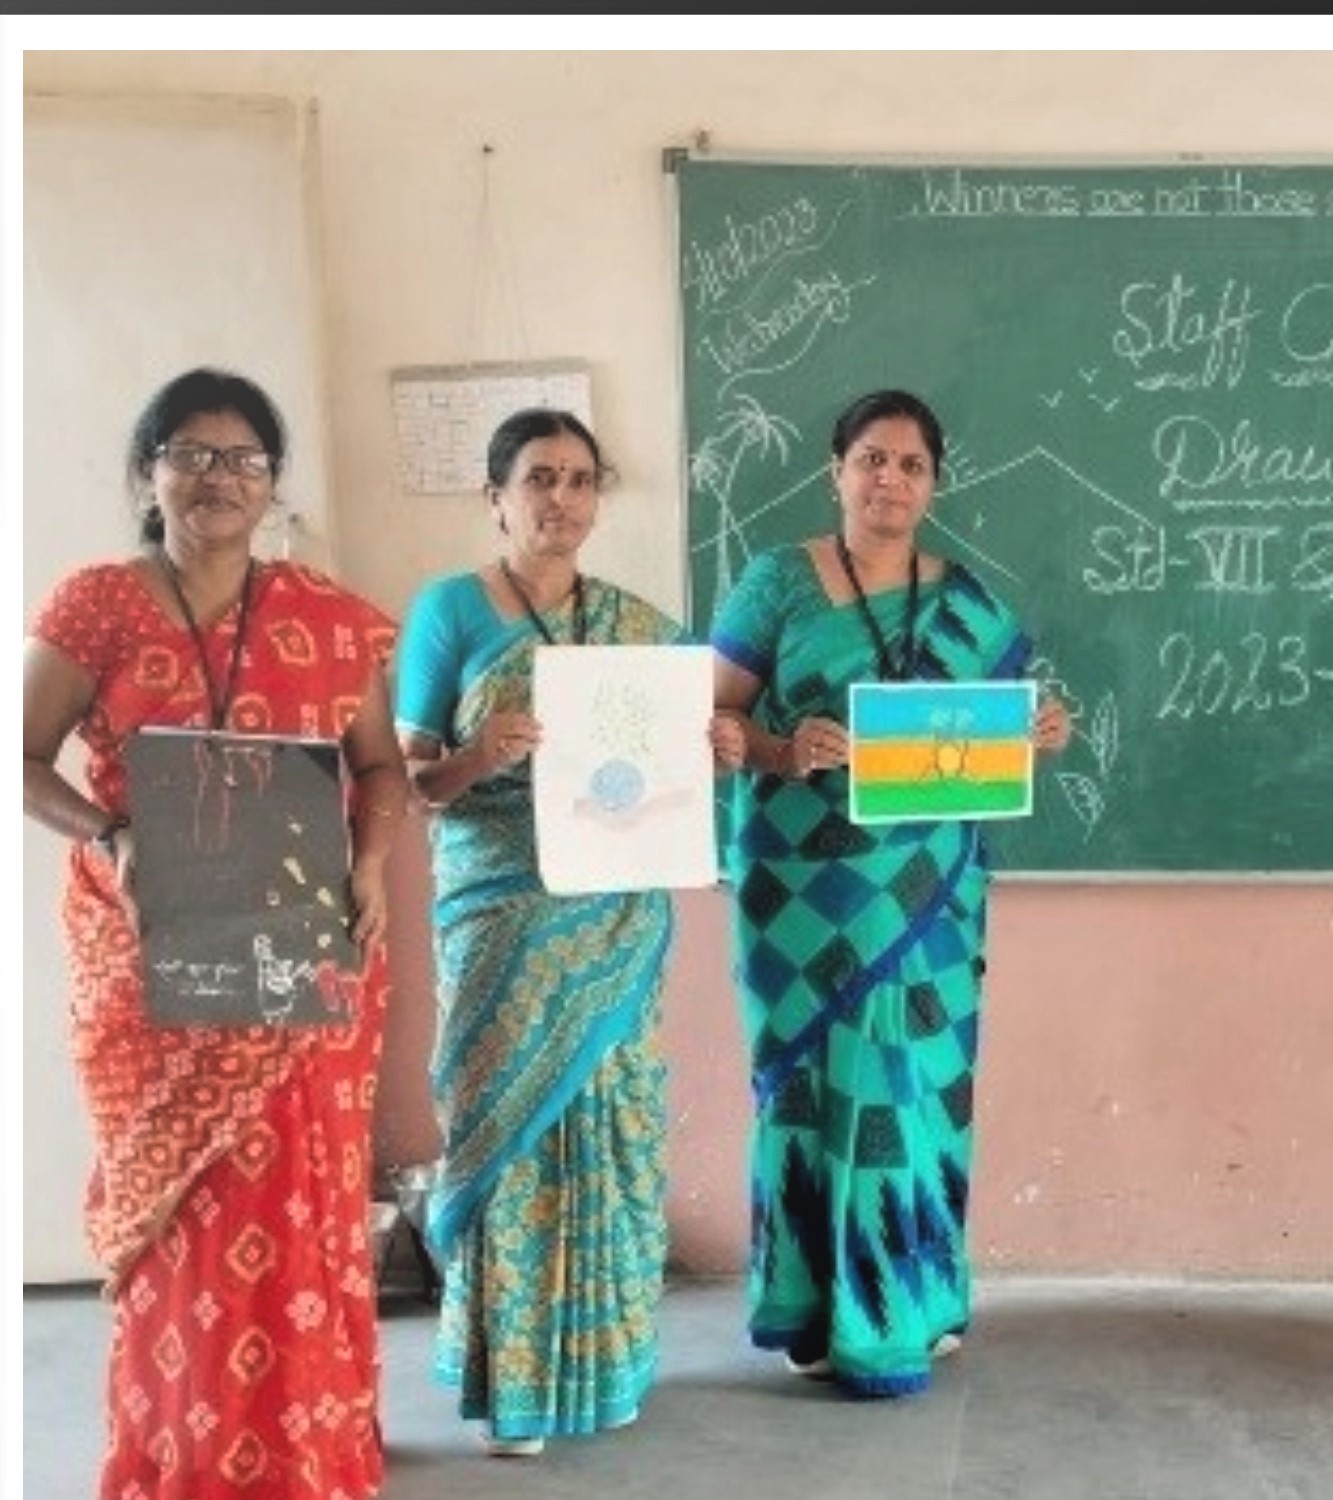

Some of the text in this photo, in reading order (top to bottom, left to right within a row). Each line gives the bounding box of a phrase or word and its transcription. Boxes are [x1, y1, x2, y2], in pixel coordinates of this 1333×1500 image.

[923, 168, 1080, 214] Winners
[1153, 176, 1208, 213] not
[1113, 274, 1262, 389] Staff
